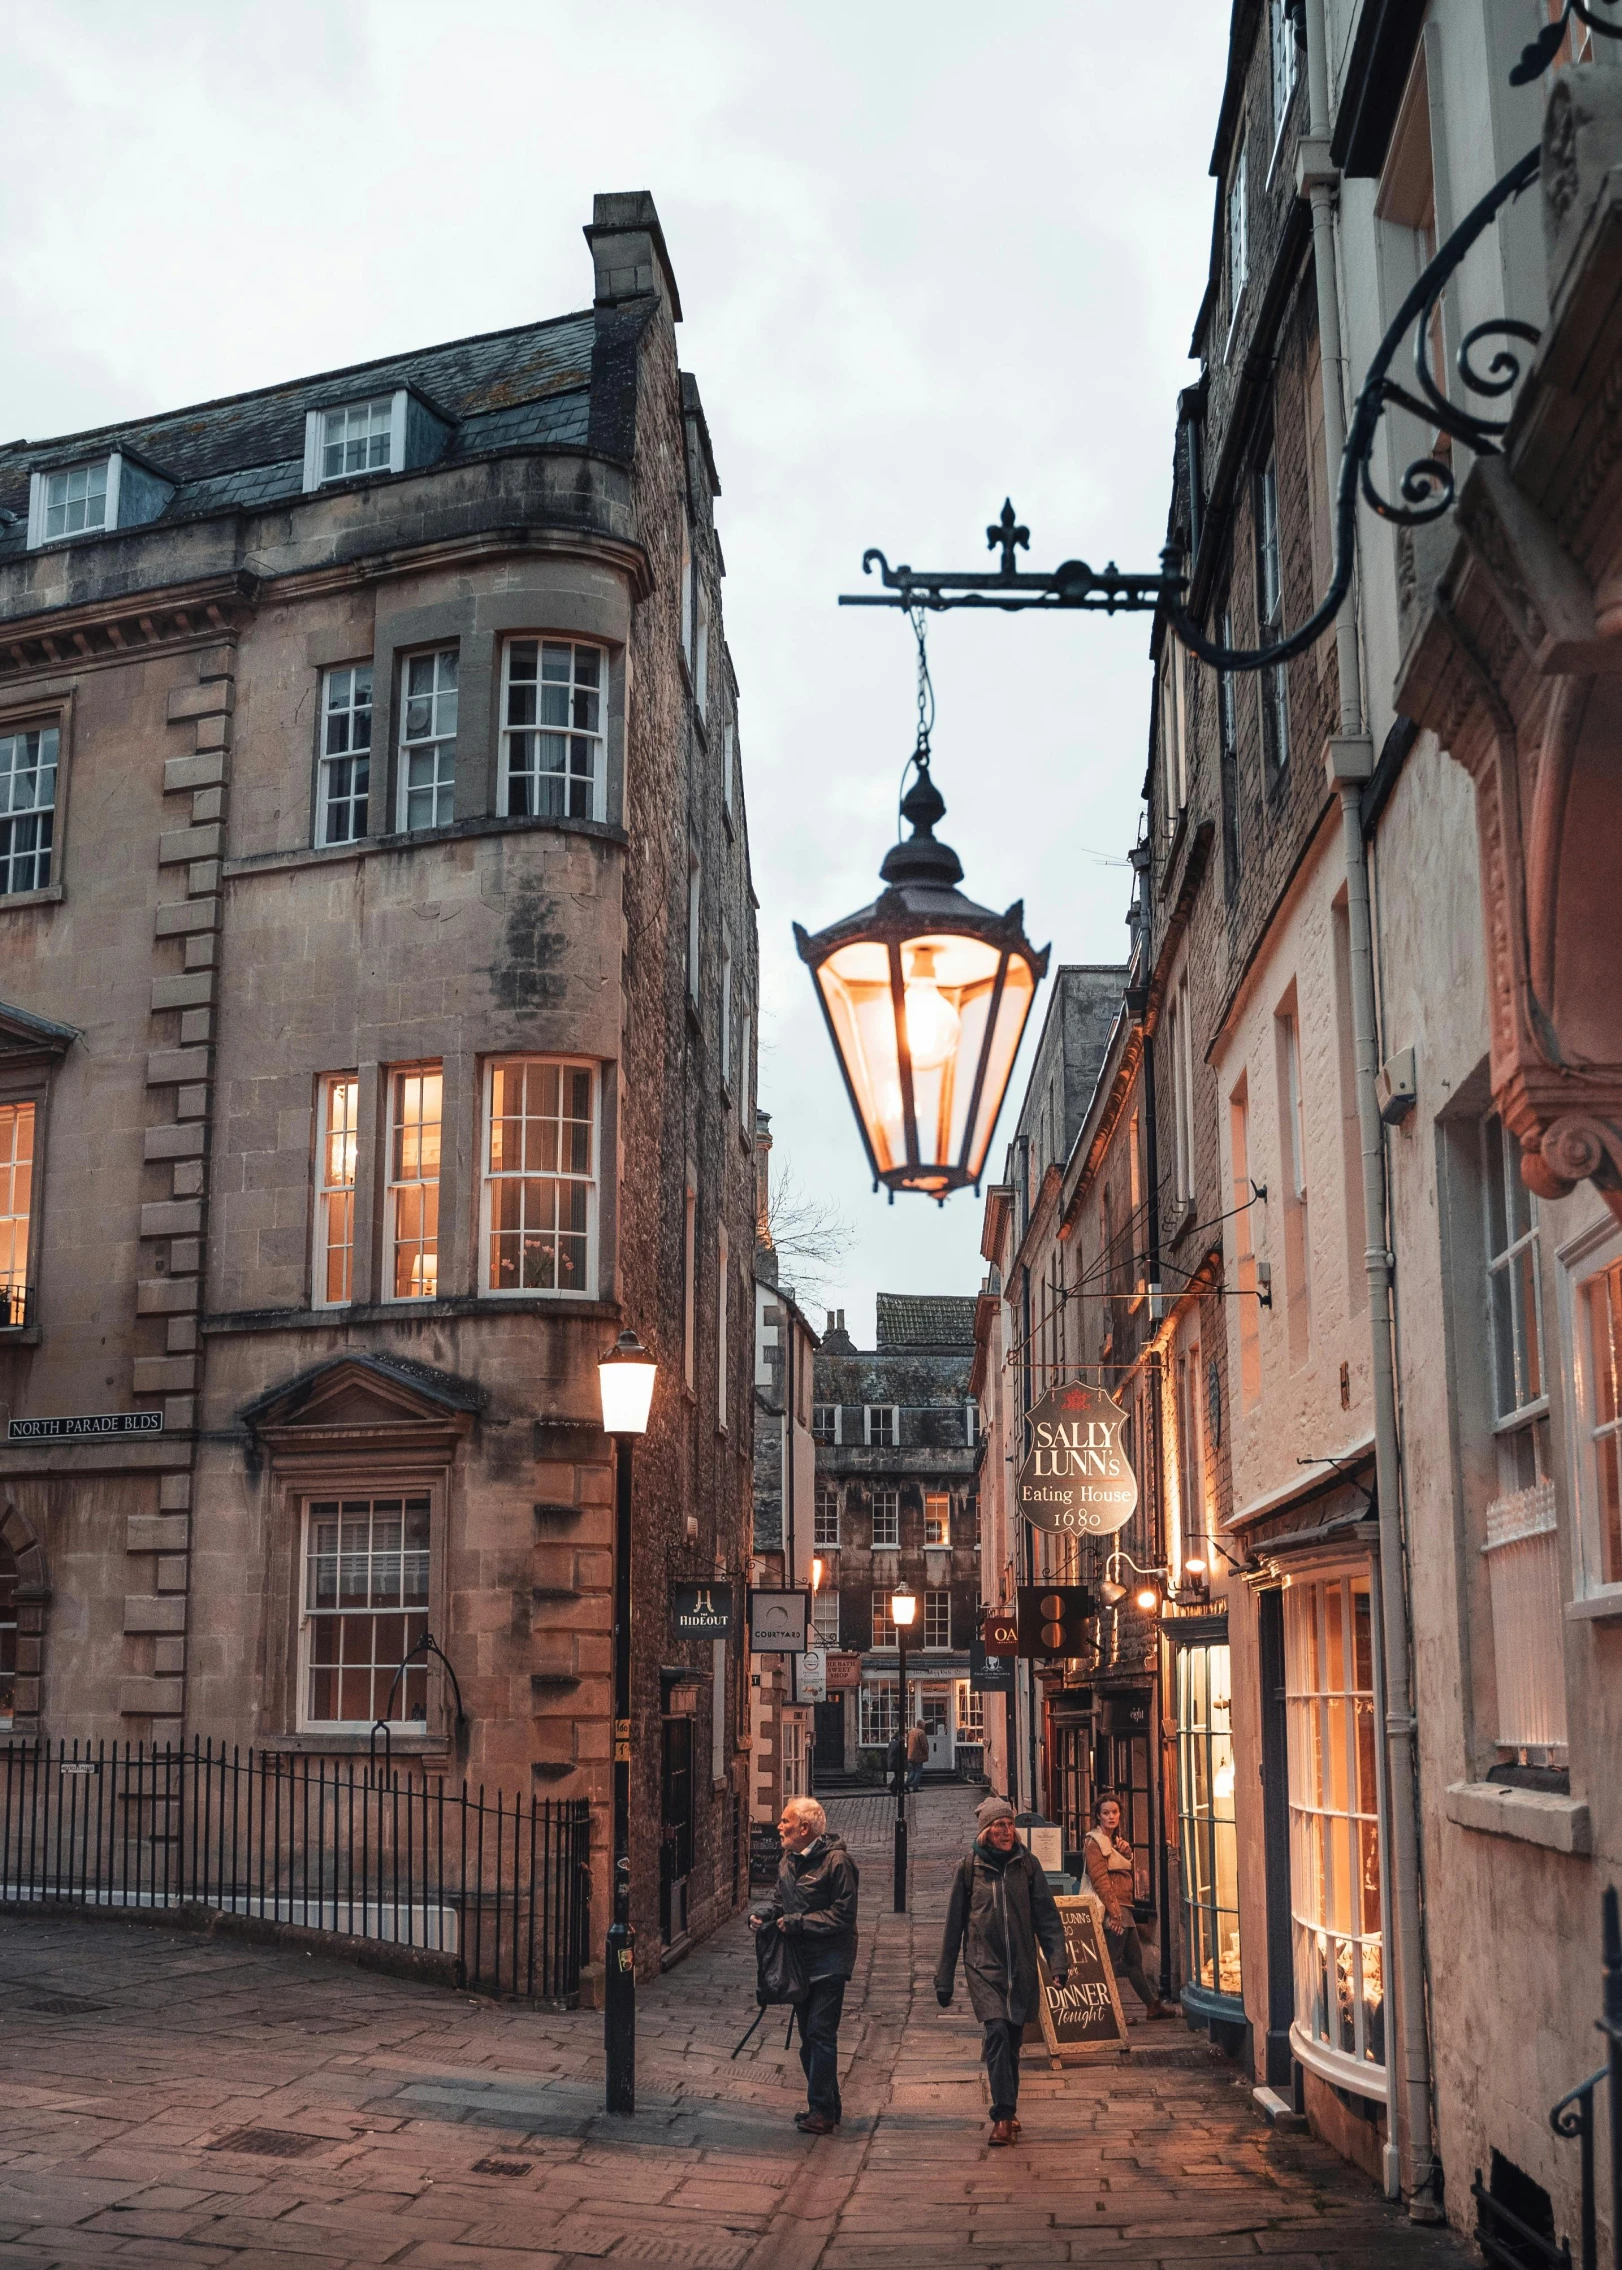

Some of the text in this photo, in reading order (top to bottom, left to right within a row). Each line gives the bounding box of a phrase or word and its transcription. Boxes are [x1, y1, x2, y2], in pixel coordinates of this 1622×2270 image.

[13, 1414, 158, 1436] NORTH PARADE BLDS
[1037, 1421, 1118, 1448] SALLY
[1033, 1449, 1121, 1476] LUNN's
[1022, 1485, 1132, 1505] Eating House
[1054, 1508, 1101, 1527] 1680
[680, 1615, 729, 1626] HIDEOUT
[755, 1631, 801, 1639] COURTYARD
[1130, 1707, 1144, 1722] eight
[1046, 1982, 1112, 2009] DINNER
[1053, 2005, 1107, 2029] Tonight
